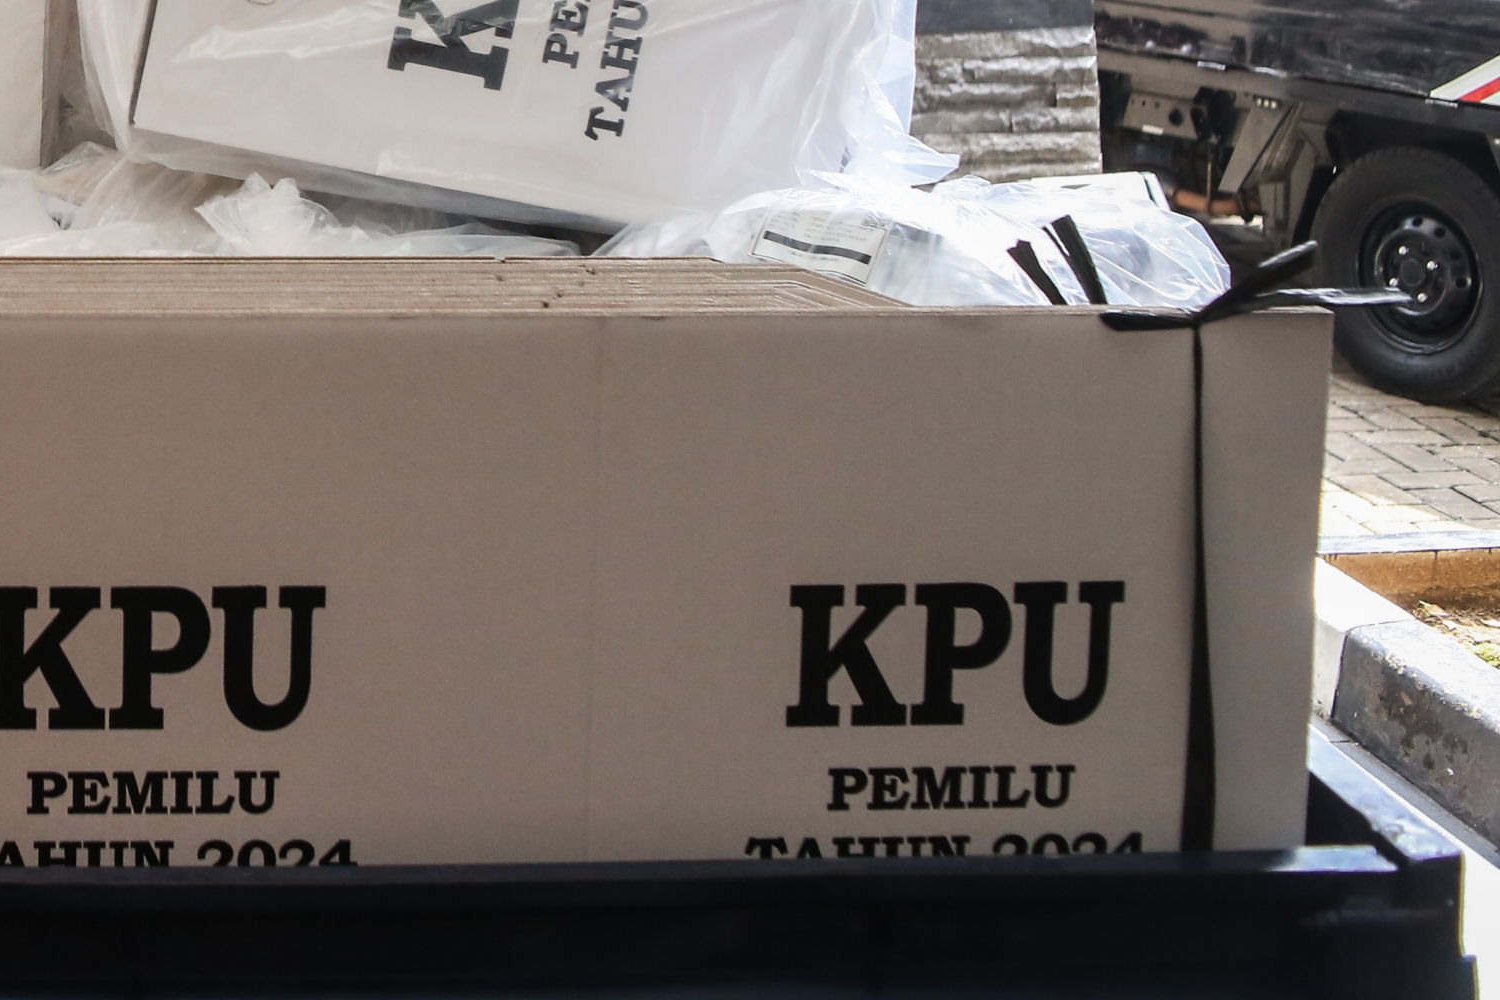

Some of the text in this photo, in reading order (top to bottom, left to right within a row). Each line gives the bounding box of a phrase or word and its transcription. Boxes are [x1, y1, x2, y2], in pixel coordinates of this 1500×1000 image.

[786, 580, 1125, 727] KPU
[27, 770, 280, 814] PEMILU
[827, 764, 1076, 811] PEMILU
